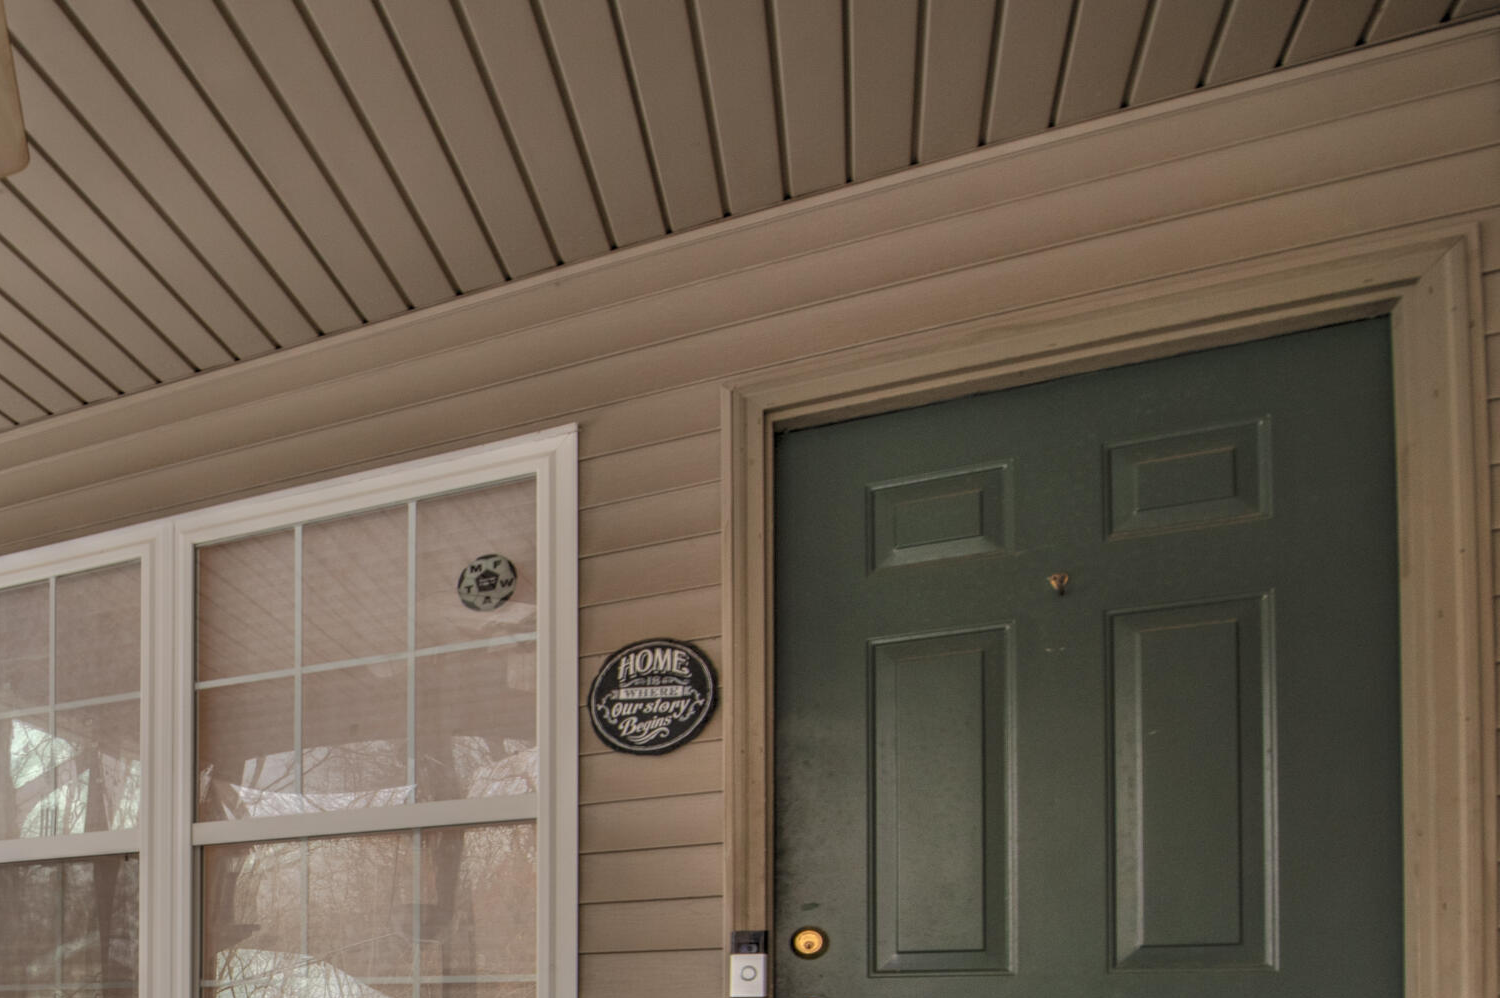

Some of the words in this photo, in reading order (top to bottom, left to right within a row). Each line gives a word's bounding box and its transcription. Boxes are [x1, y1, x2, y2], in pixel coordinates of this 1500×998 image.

[470, 564, 483, 573] M
[493, 560, 502, 568] F
[499, 578, 514, 588] W
[618, 647, 692, 681] HOME
[624, 686, 679, 698] WHERE
[643, 698, 692, 718] story
[618, 715, 673, 737] Begins
